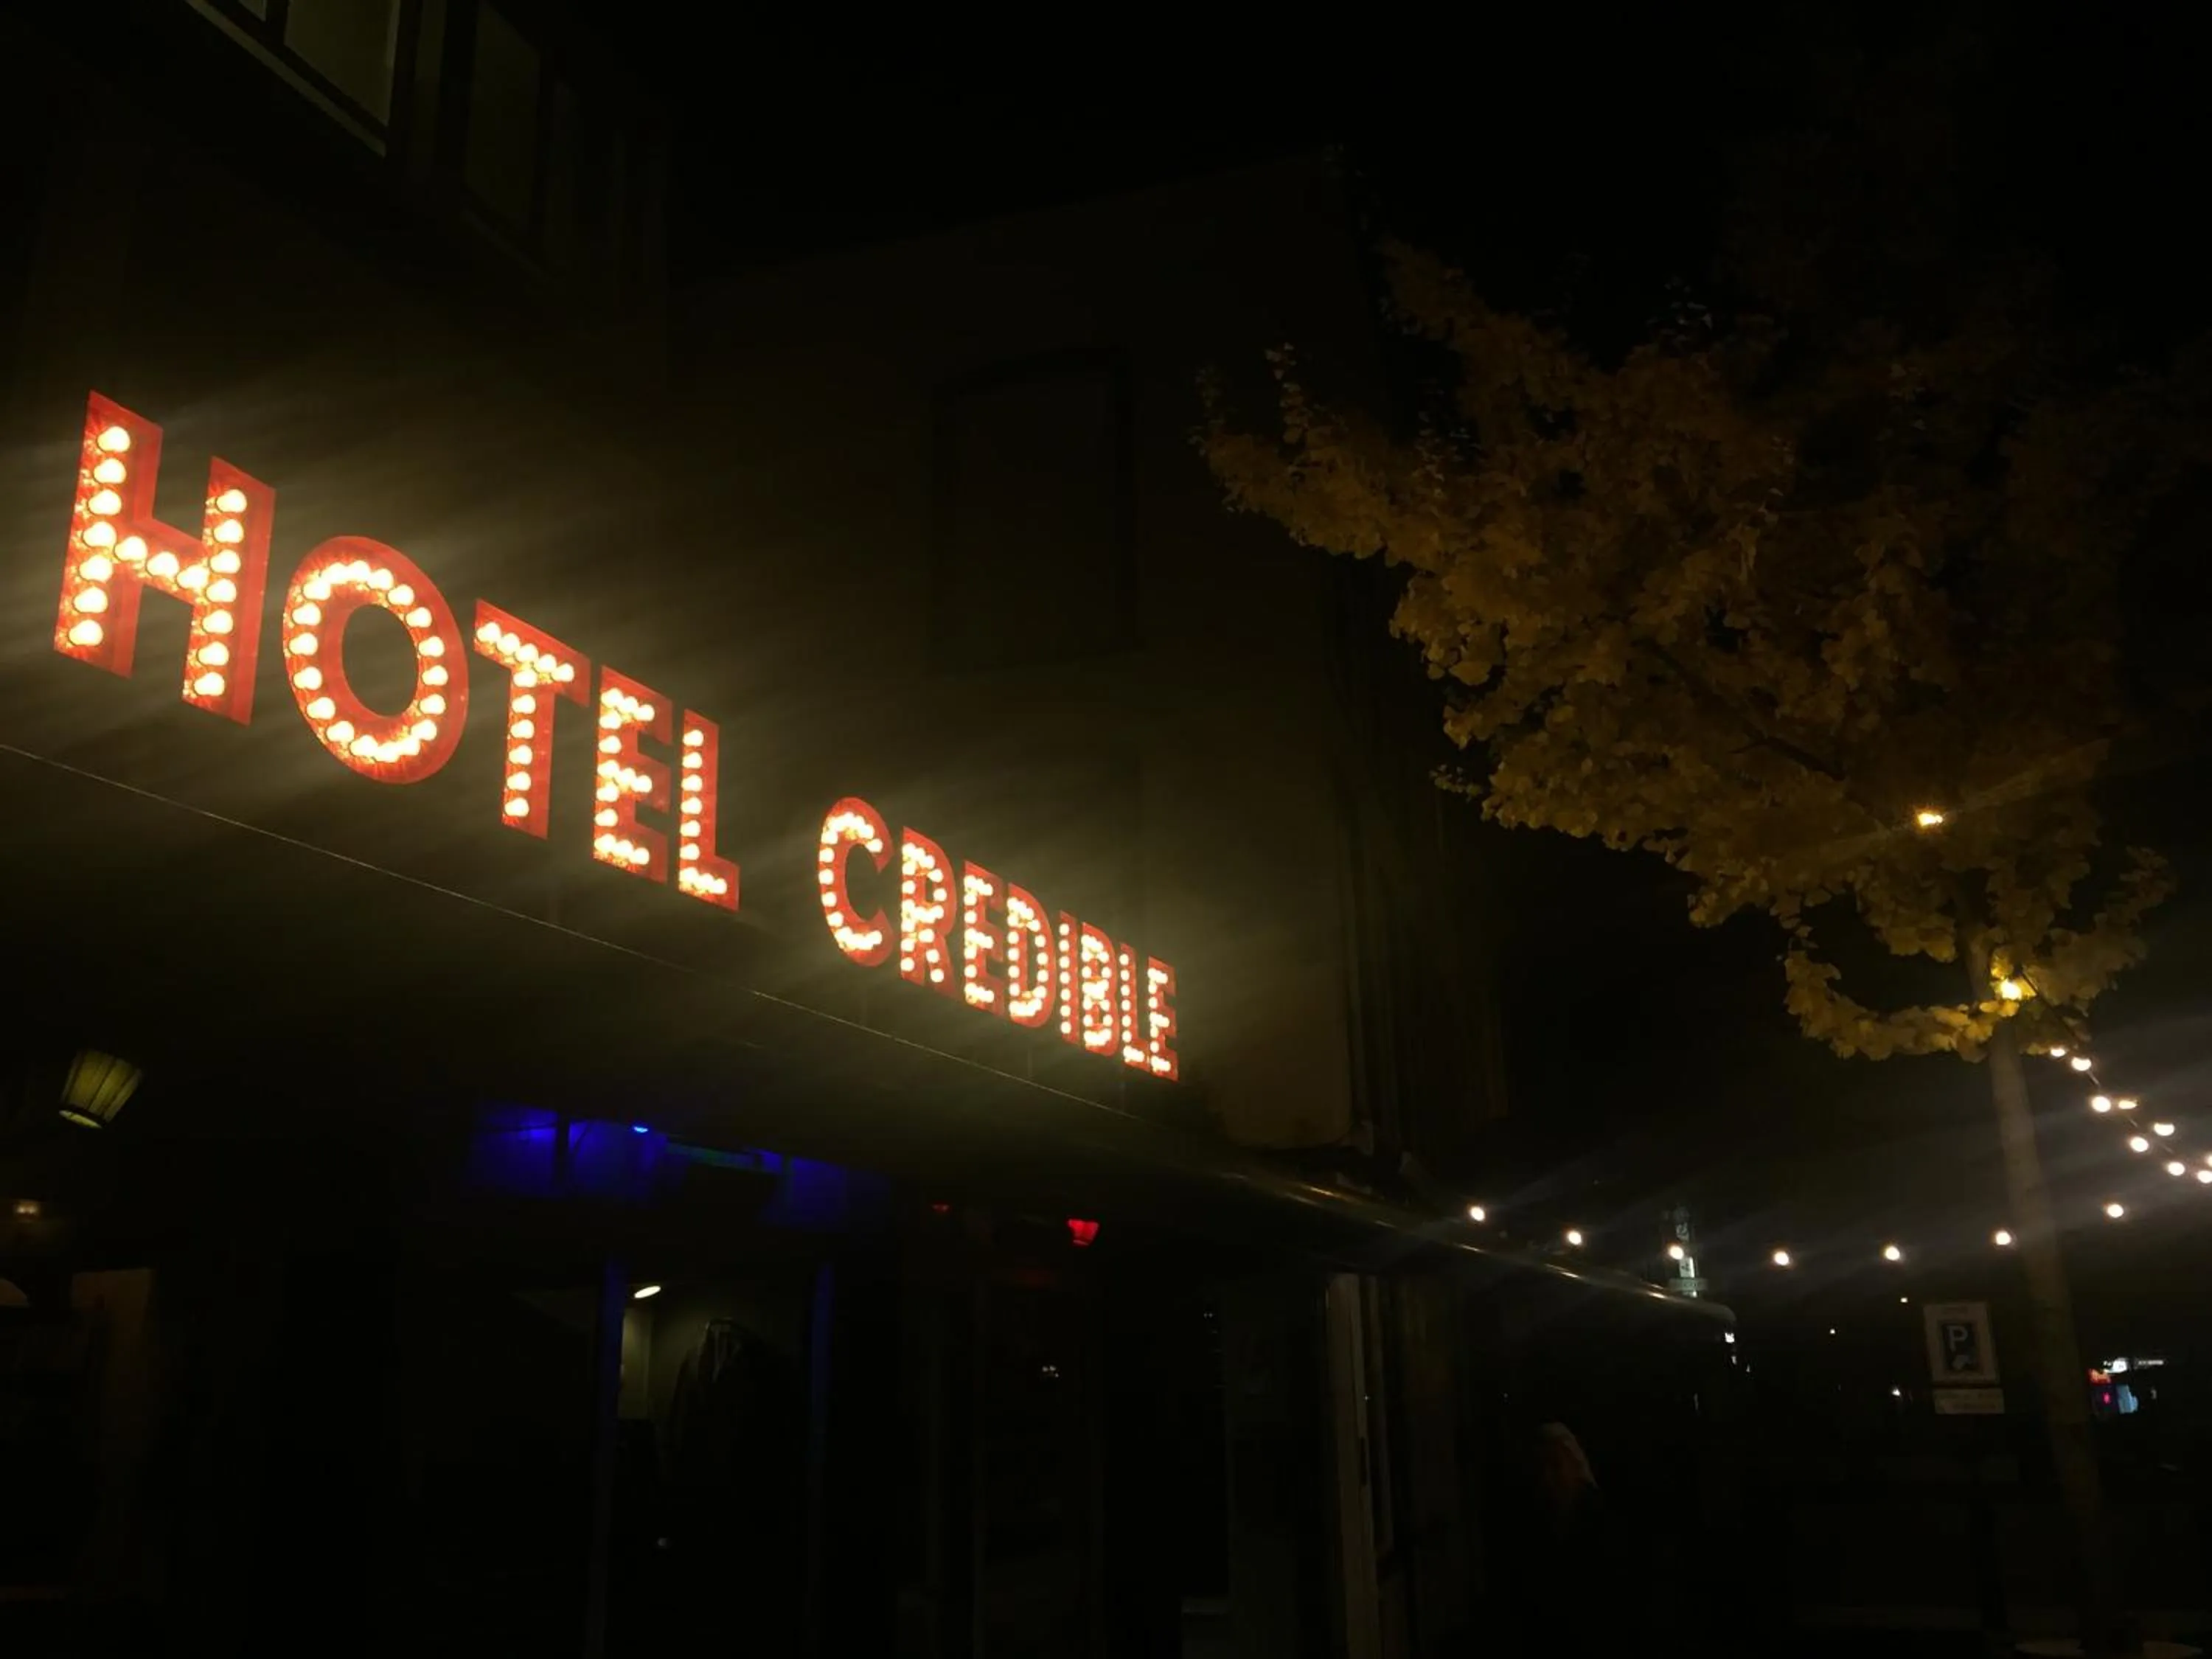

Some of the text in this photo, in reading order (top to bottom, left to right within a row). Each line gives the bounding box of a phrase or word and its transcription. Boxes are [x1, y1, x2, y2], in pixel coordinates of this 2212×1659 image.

[54, 390, 1178, 1082] HOTEL CREDIBLE
[1946, 1324, 1969, 1354] P
